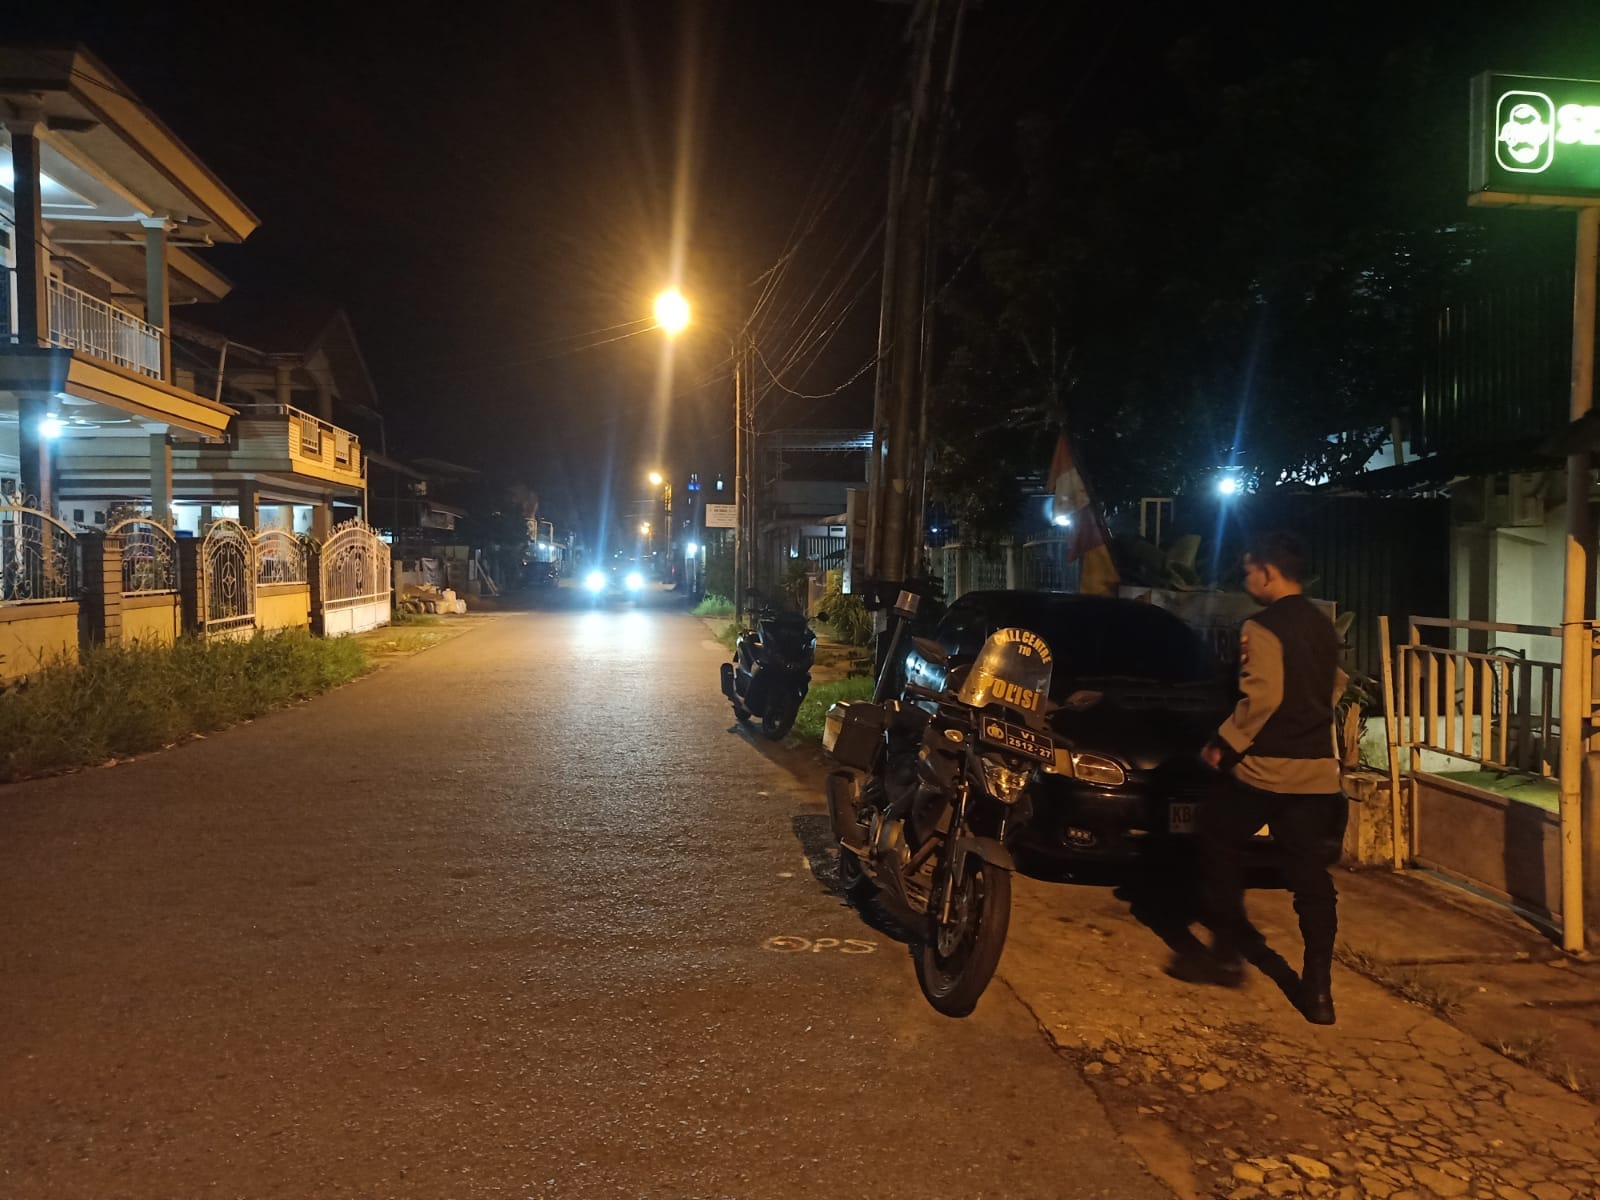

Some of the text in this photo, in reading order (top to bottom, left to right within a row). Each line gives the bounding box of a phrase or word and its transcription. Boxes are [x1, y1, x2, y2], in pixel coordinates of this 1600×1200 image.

[1018, 644, 1032, 657] 110
[1022, 631, 1052, 664] CENTRE
[984, 676, 1041, 711] POLISI
